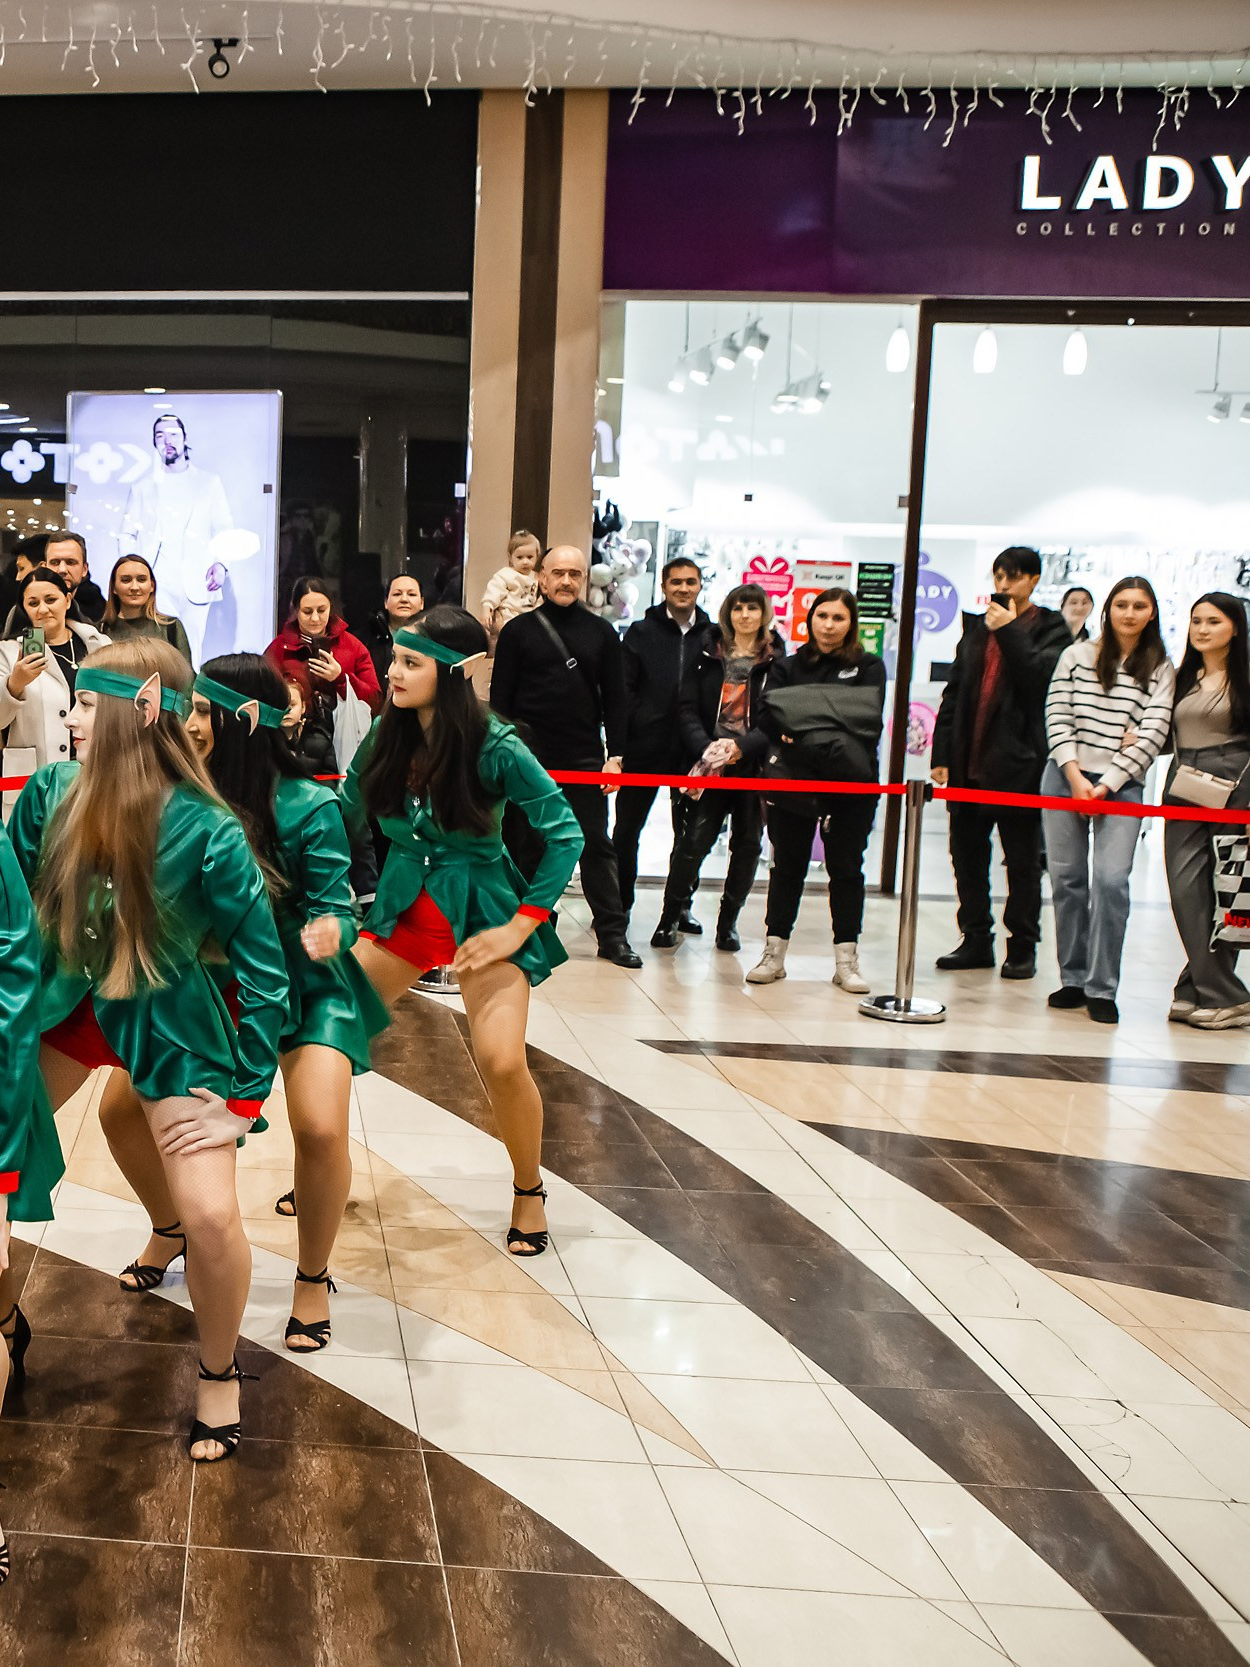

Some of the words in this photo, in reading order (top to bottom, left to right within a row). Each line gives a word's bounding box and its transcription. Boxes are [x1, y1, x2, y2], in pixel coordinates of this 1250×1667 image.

[1021, 155, 1250, 210] LADY
[1016, 222, 1236, 236] COLLECTION
[918, 585, 953, 600] ADY
[1224, 912, 1250, 928] NE
